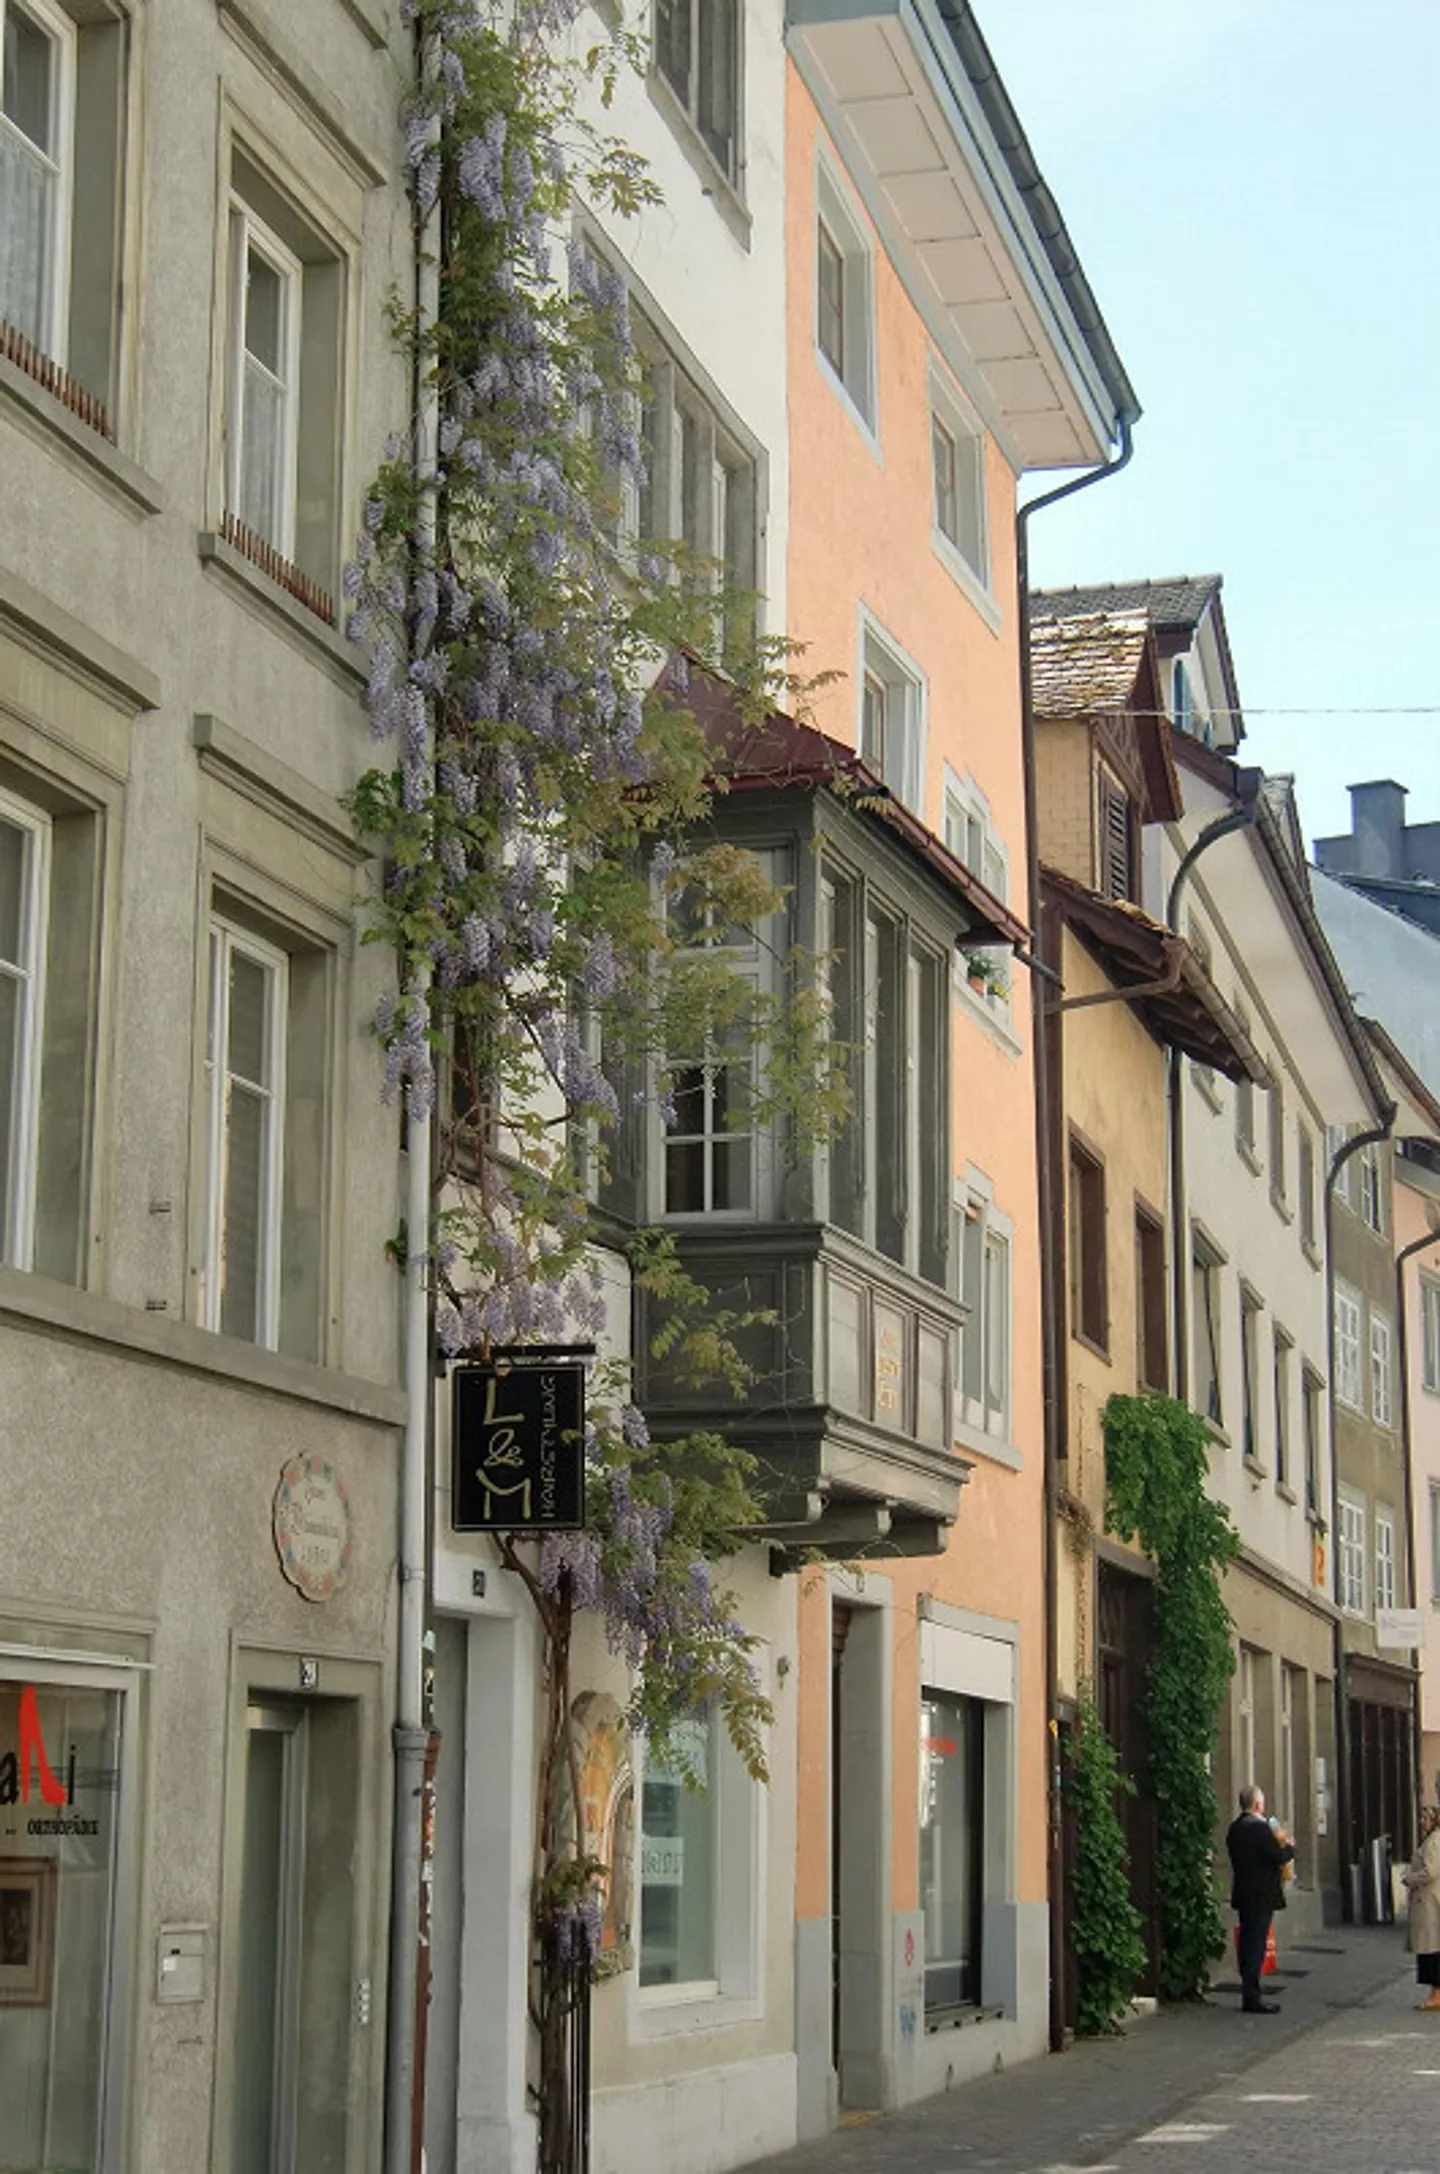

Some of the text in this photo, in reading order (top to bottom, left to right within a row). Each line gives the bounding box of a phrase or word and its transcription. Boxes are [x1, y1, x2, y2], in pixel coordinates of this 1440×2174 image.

[476, 1377, 532, 1520] L & M
